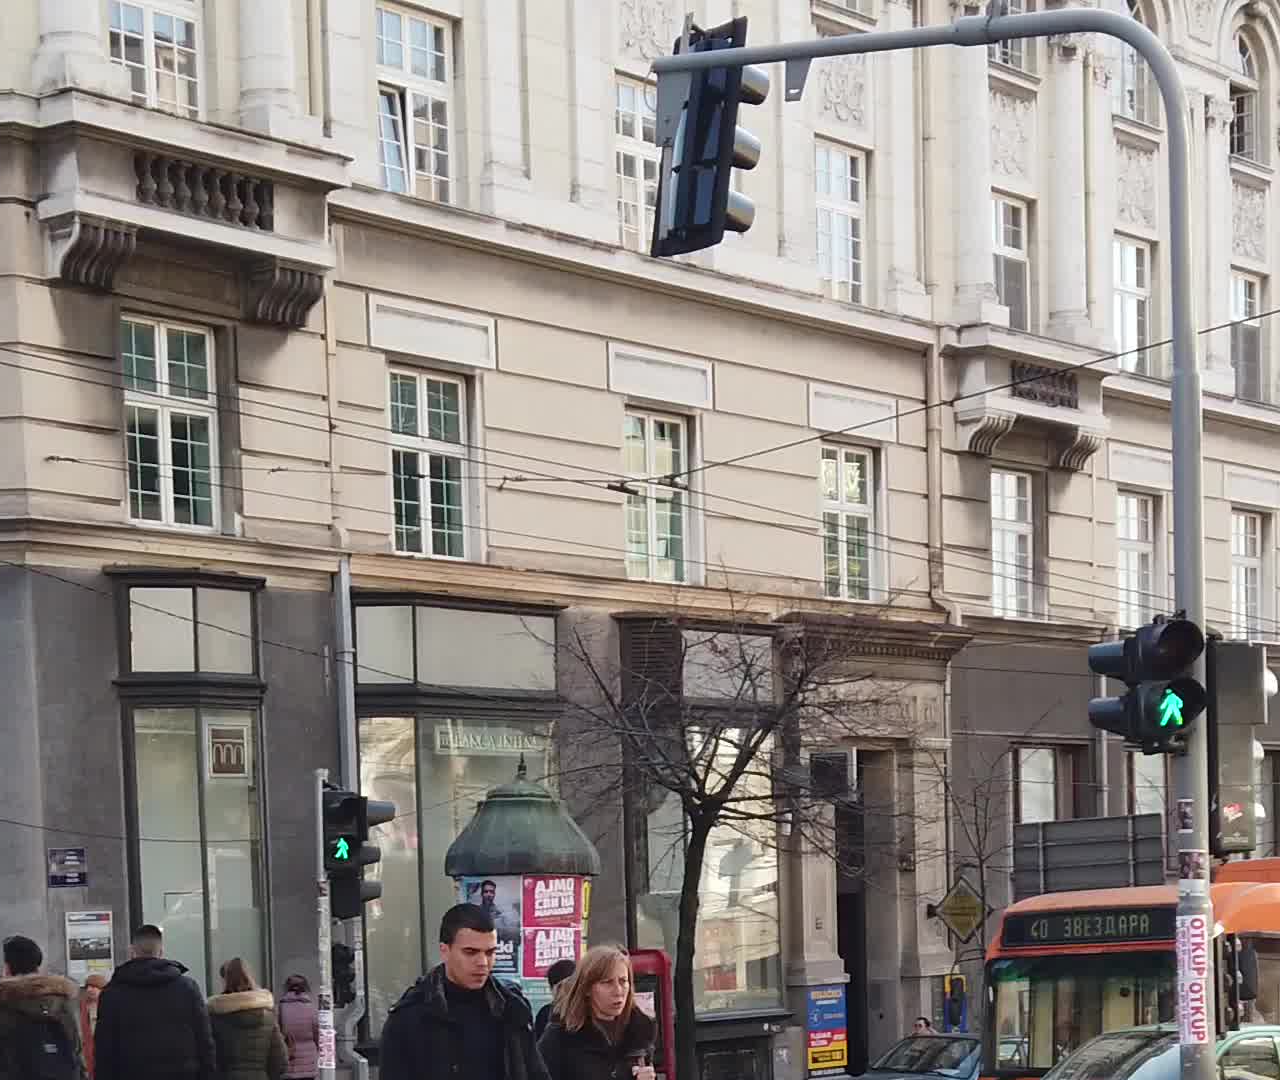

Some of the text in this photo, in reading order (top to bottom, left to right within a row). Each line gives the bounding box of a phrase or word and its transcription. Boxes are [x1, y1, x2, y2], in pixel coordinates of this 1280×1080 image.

[1031, 914, 1150, 939] 40 ЗВЕЗДАРА
[1190, 918, 1205, 977] OTKUP
[1189, 982, 1206, 1040] OTKUP
